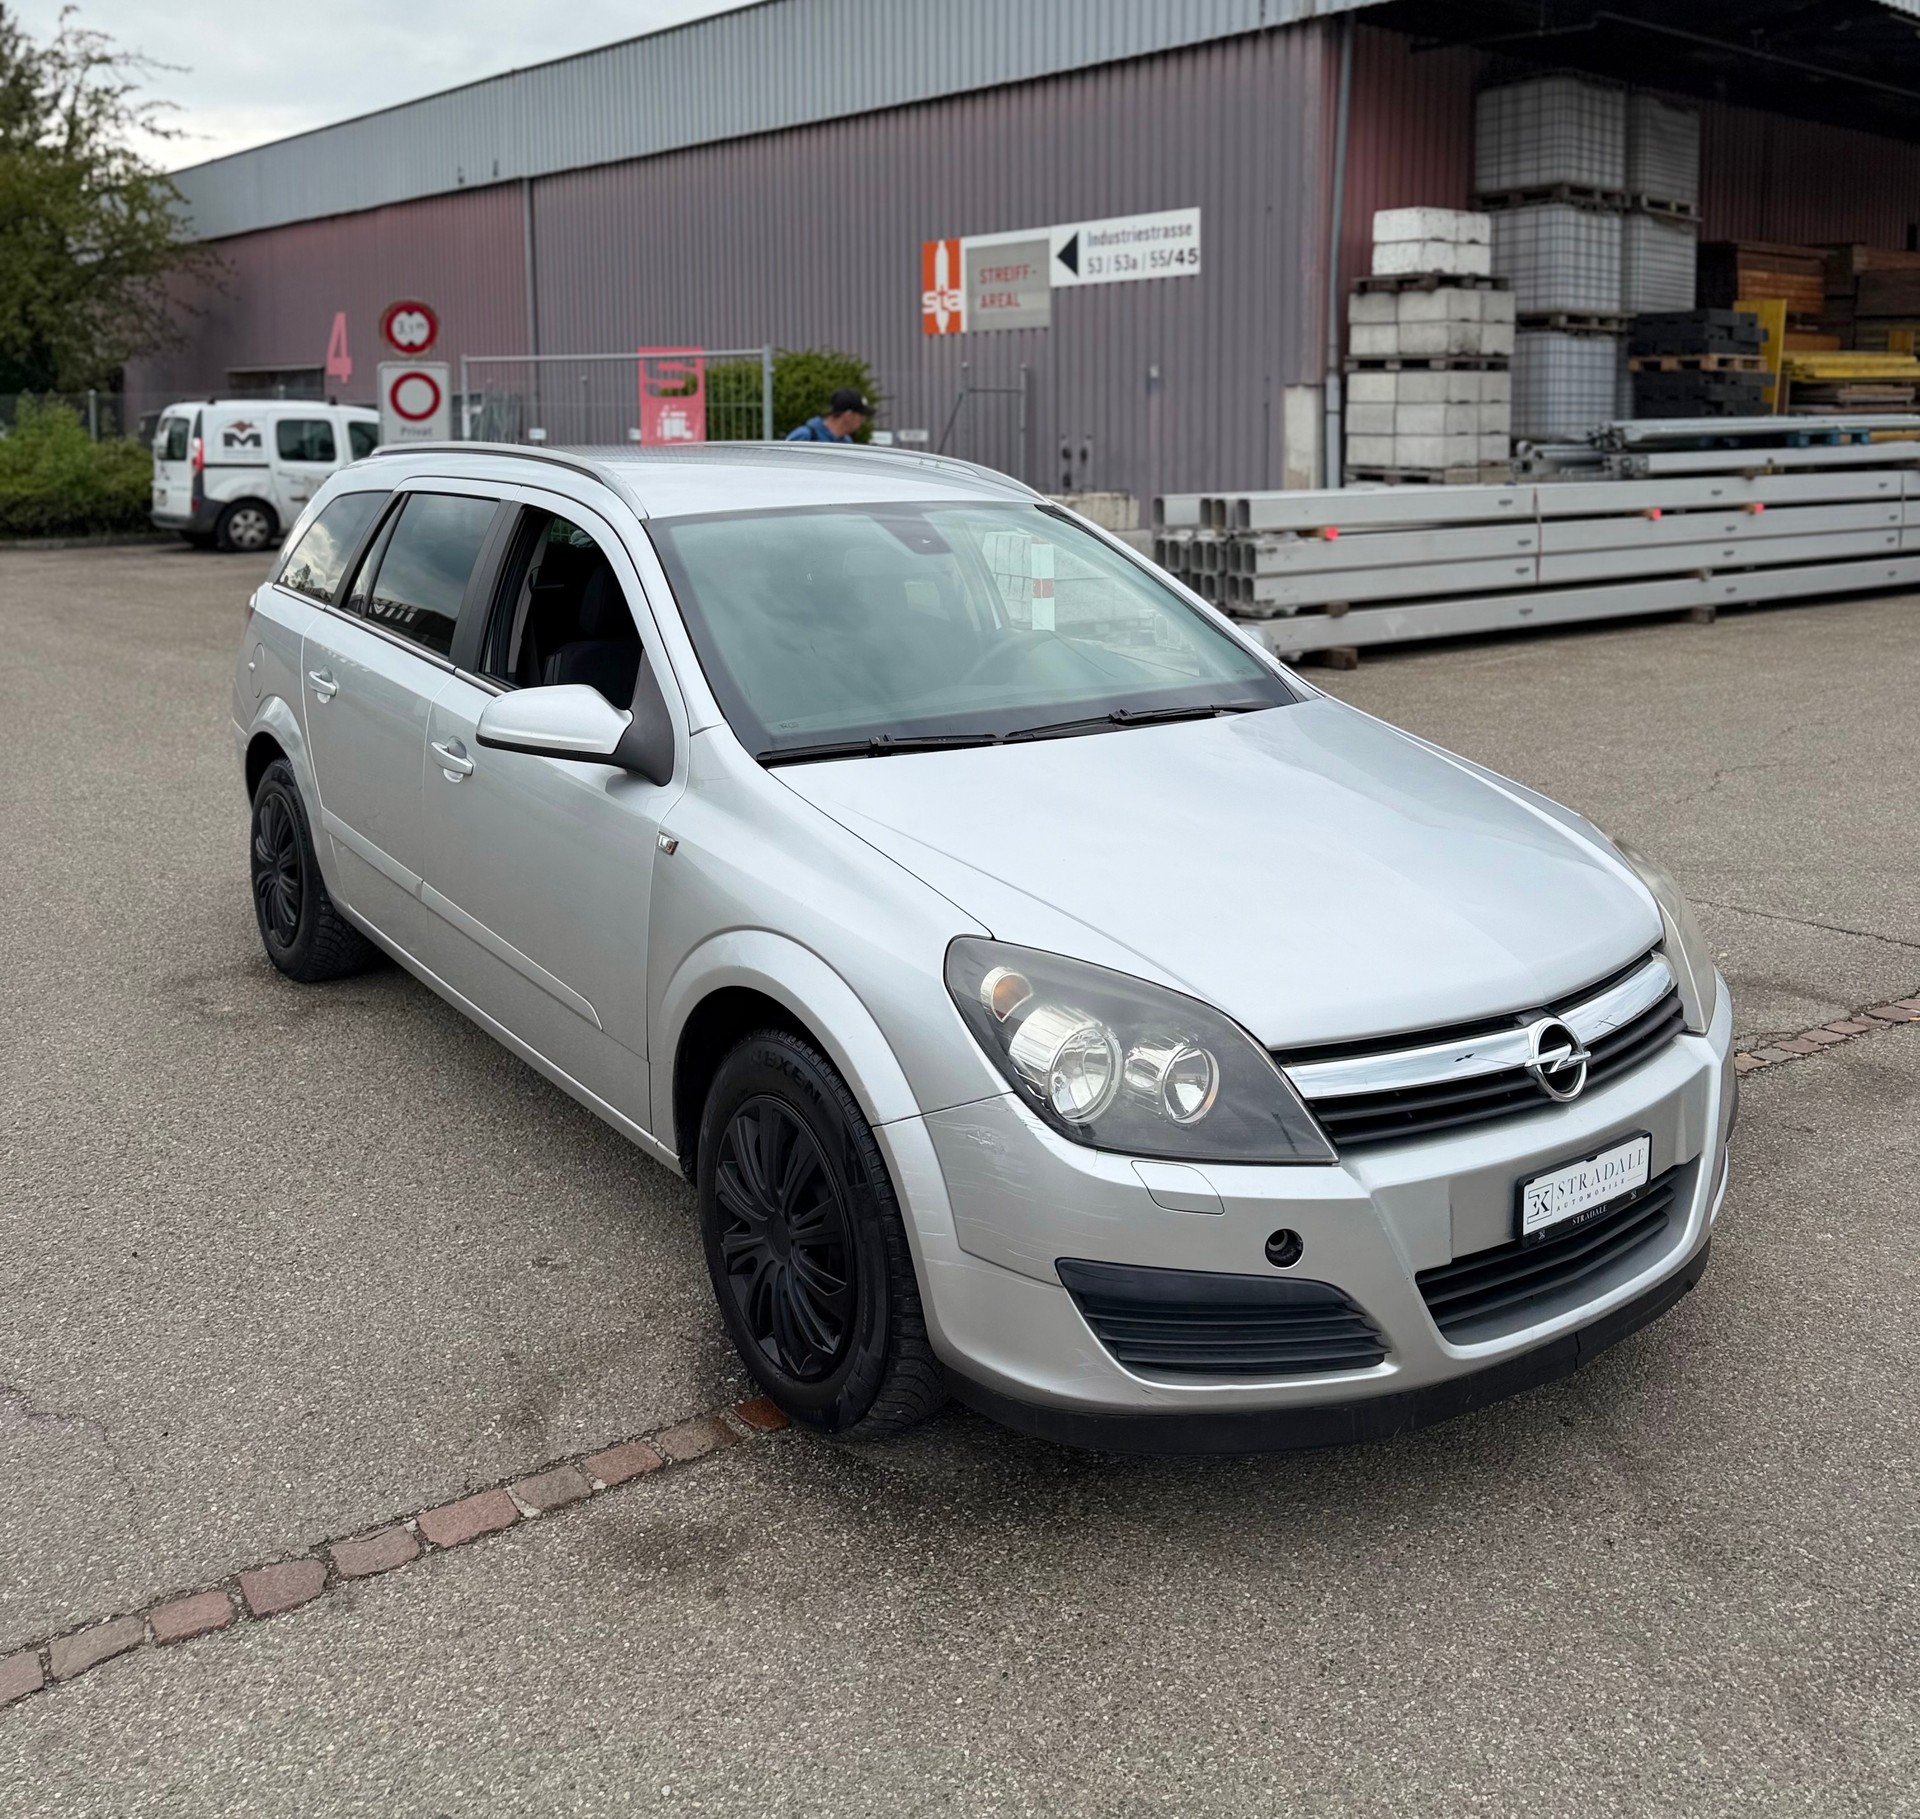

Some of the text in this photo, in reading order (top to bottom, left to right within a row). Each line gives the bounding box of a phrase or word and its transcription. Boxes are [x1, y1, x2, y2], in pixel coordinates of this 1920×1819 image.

[1088, 224, 1192, 248] Industriestrasse
[1088, 256, 1102, 274] 53
[1115, 253, 1137, 272] 53a
[980, 292, 1020, 308] AREAL
[327, 312, 352, 384] 4
[750, 1049, 822, 1107] NEXEN
[1557, 1148, 1645, 1200] STRADALE
[1556, 1178, 1625, 1212] AUTOMOBILE
[1572, 1204, 1607, 1226] STRADALE
